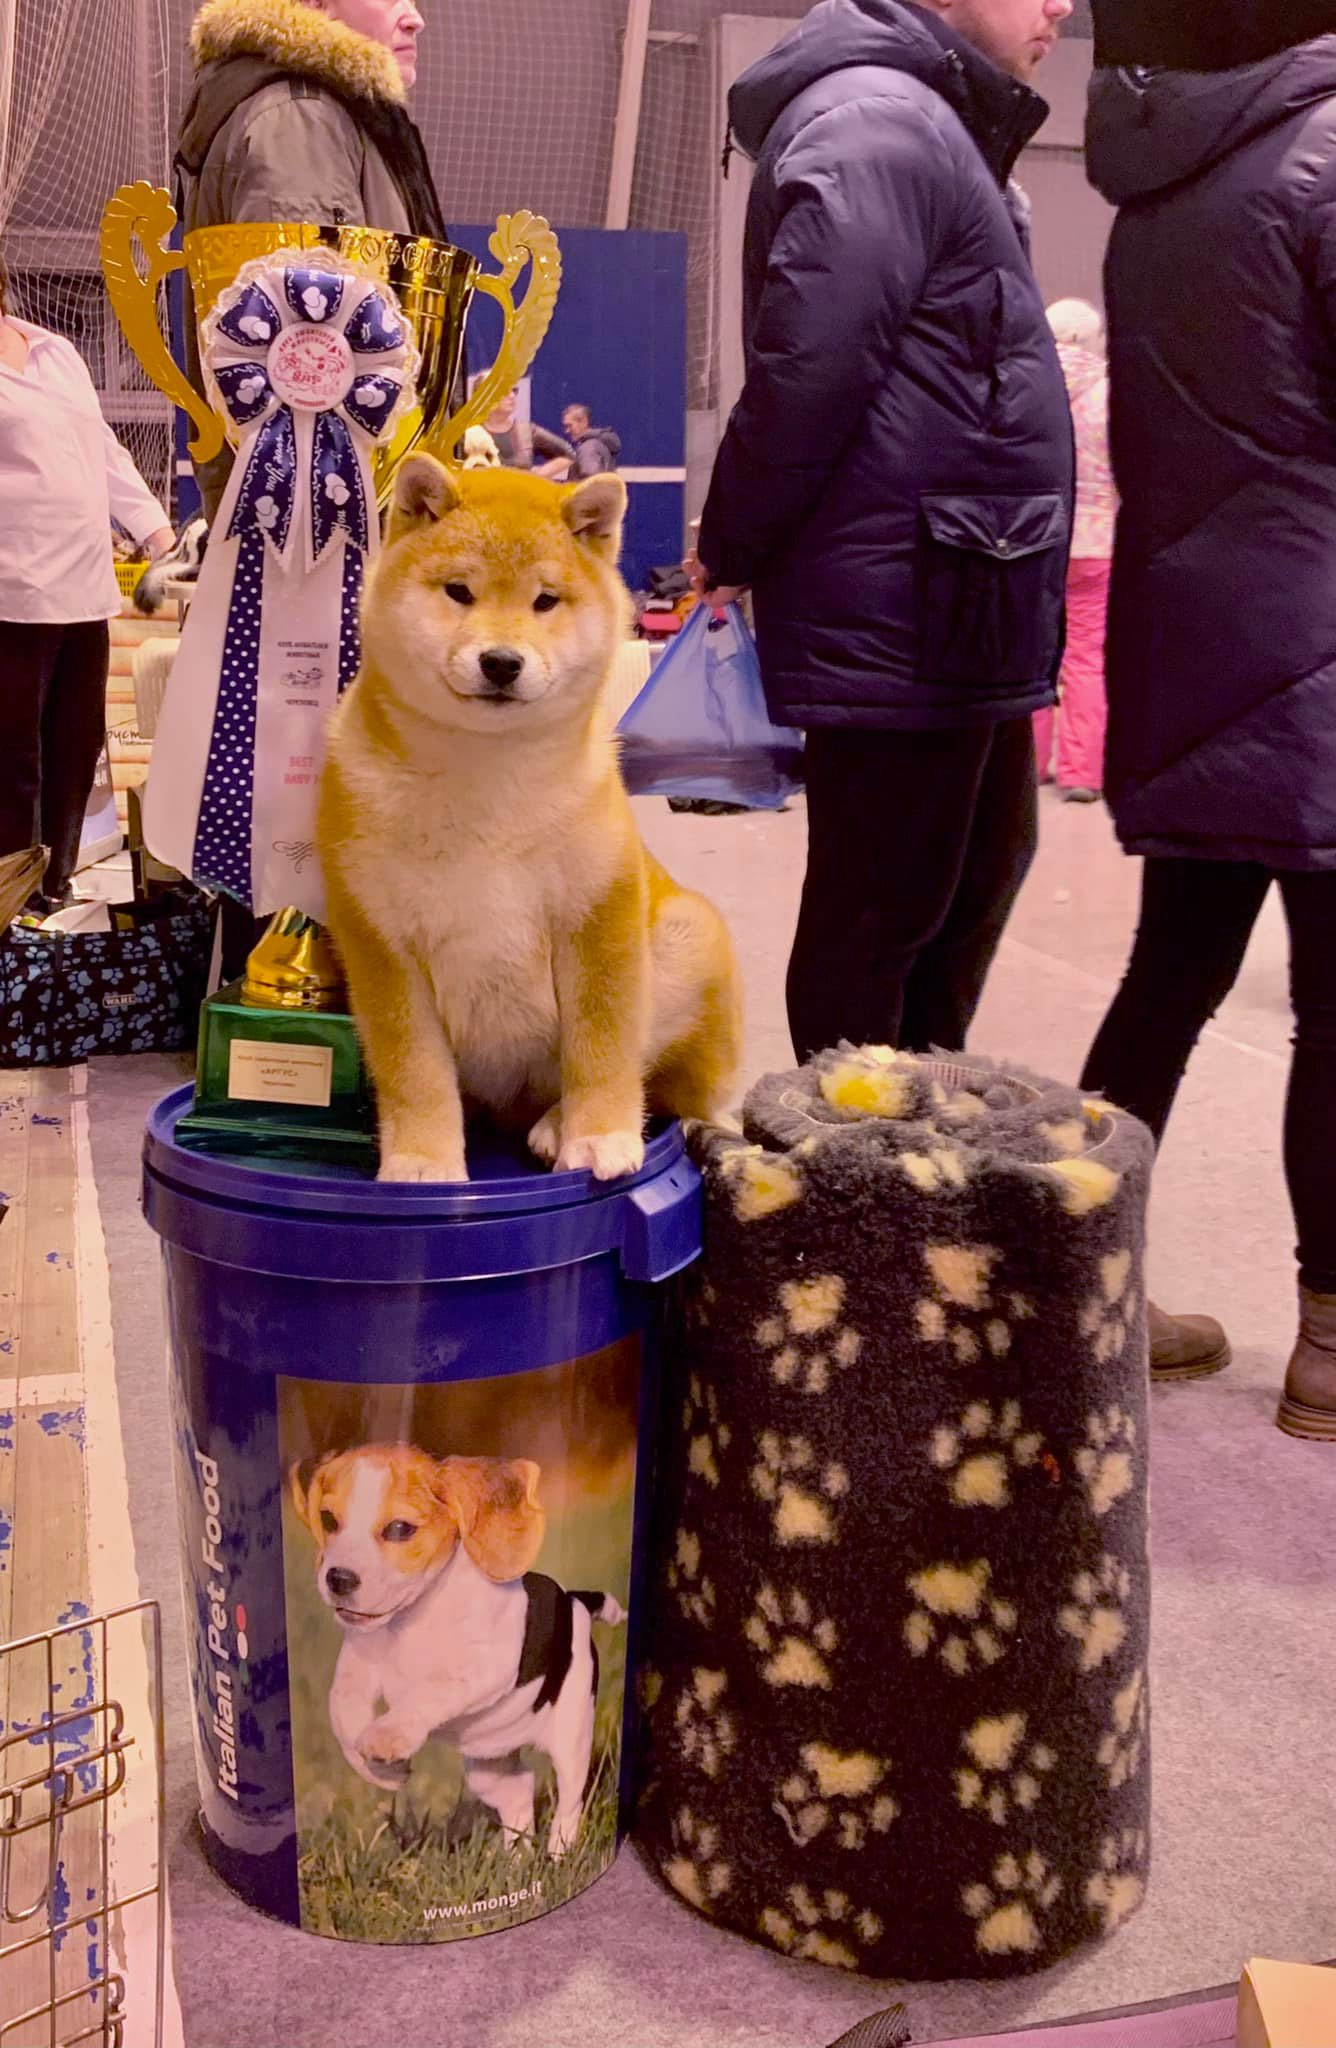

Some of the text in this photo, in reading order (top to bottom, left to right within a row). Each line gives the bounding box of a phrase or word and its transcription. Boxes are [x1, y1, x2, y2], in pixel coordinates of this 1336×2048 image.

[194, 1450, 239, 1801] Italian Pet Food
[423, 1881, 542, 1920] www.monge.it
